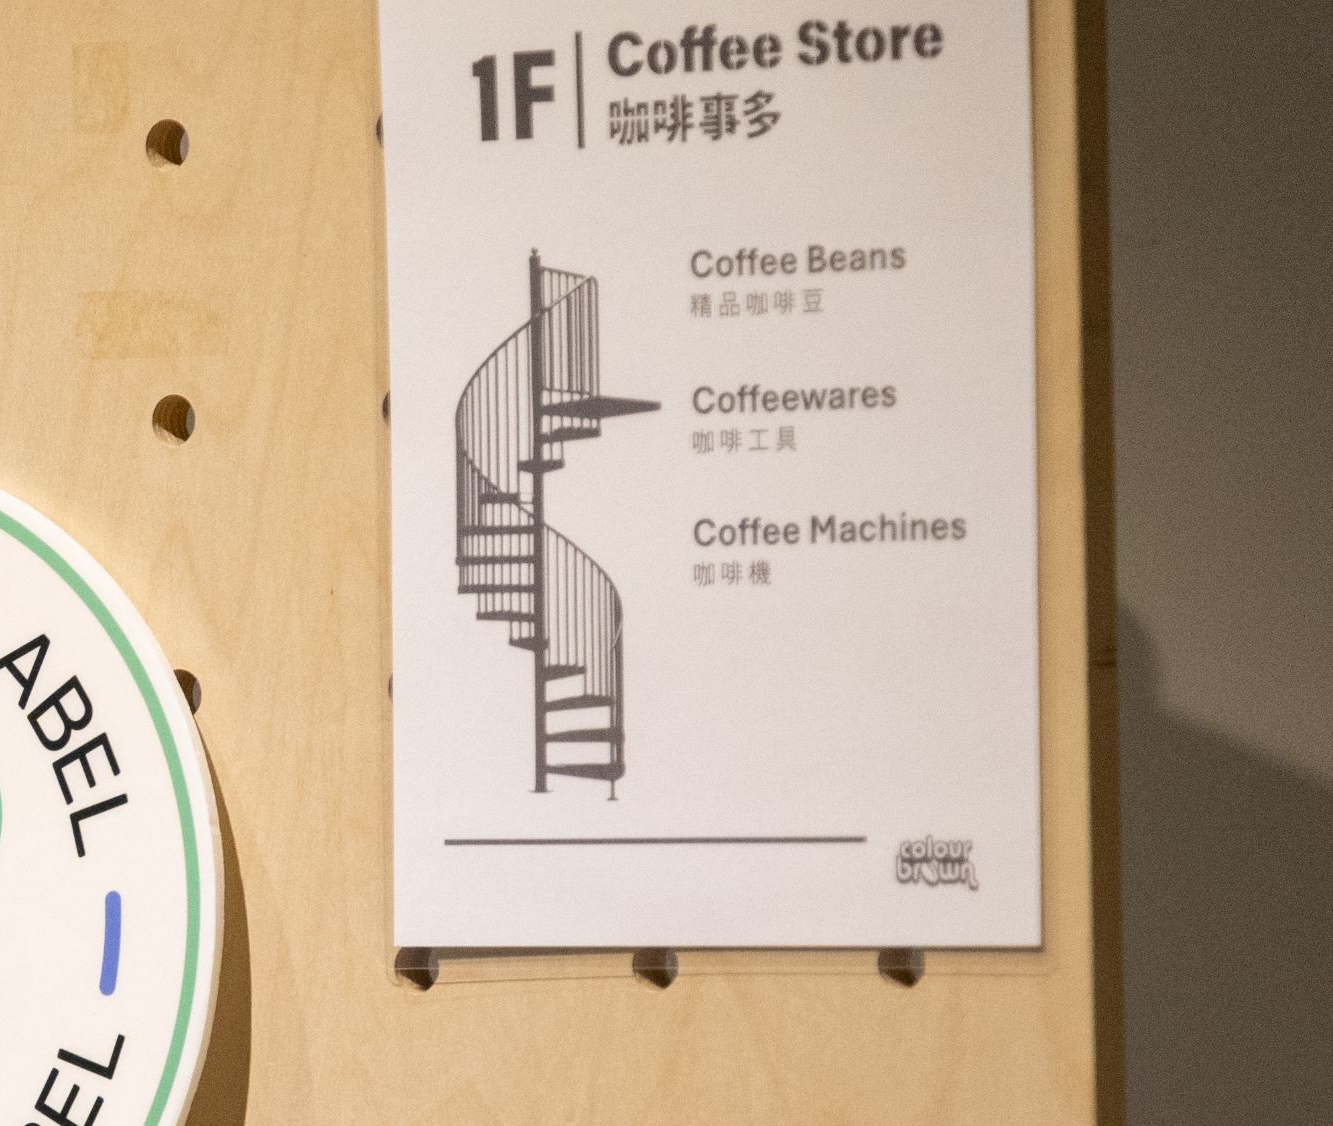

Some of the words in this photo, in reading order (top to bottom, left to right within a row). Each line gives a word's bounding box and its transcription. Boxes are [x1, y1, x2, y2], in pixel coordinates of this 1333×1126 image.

[608, 23, 782, 76] Coffee
[798, 20, 945, 65] Store
[471, 49, 555, 142] 1F
[608, 89, 782, 146] 咖啡事多
[690, 248, 798, 279] Coffee
[807, 244, 907, 274] Beans
[690, 287, 824, 318] 精品咖啡豆
[692, 381, 897, 415] Coffeewares
[692, 426, 798, 454] 咖啡工具
[694, 516, 800, 547] Coffee
[809, 512, 967, 543] Machines
[693, 560, 772, 587] 咖啡機
[900, 835, 974, 860] colour
